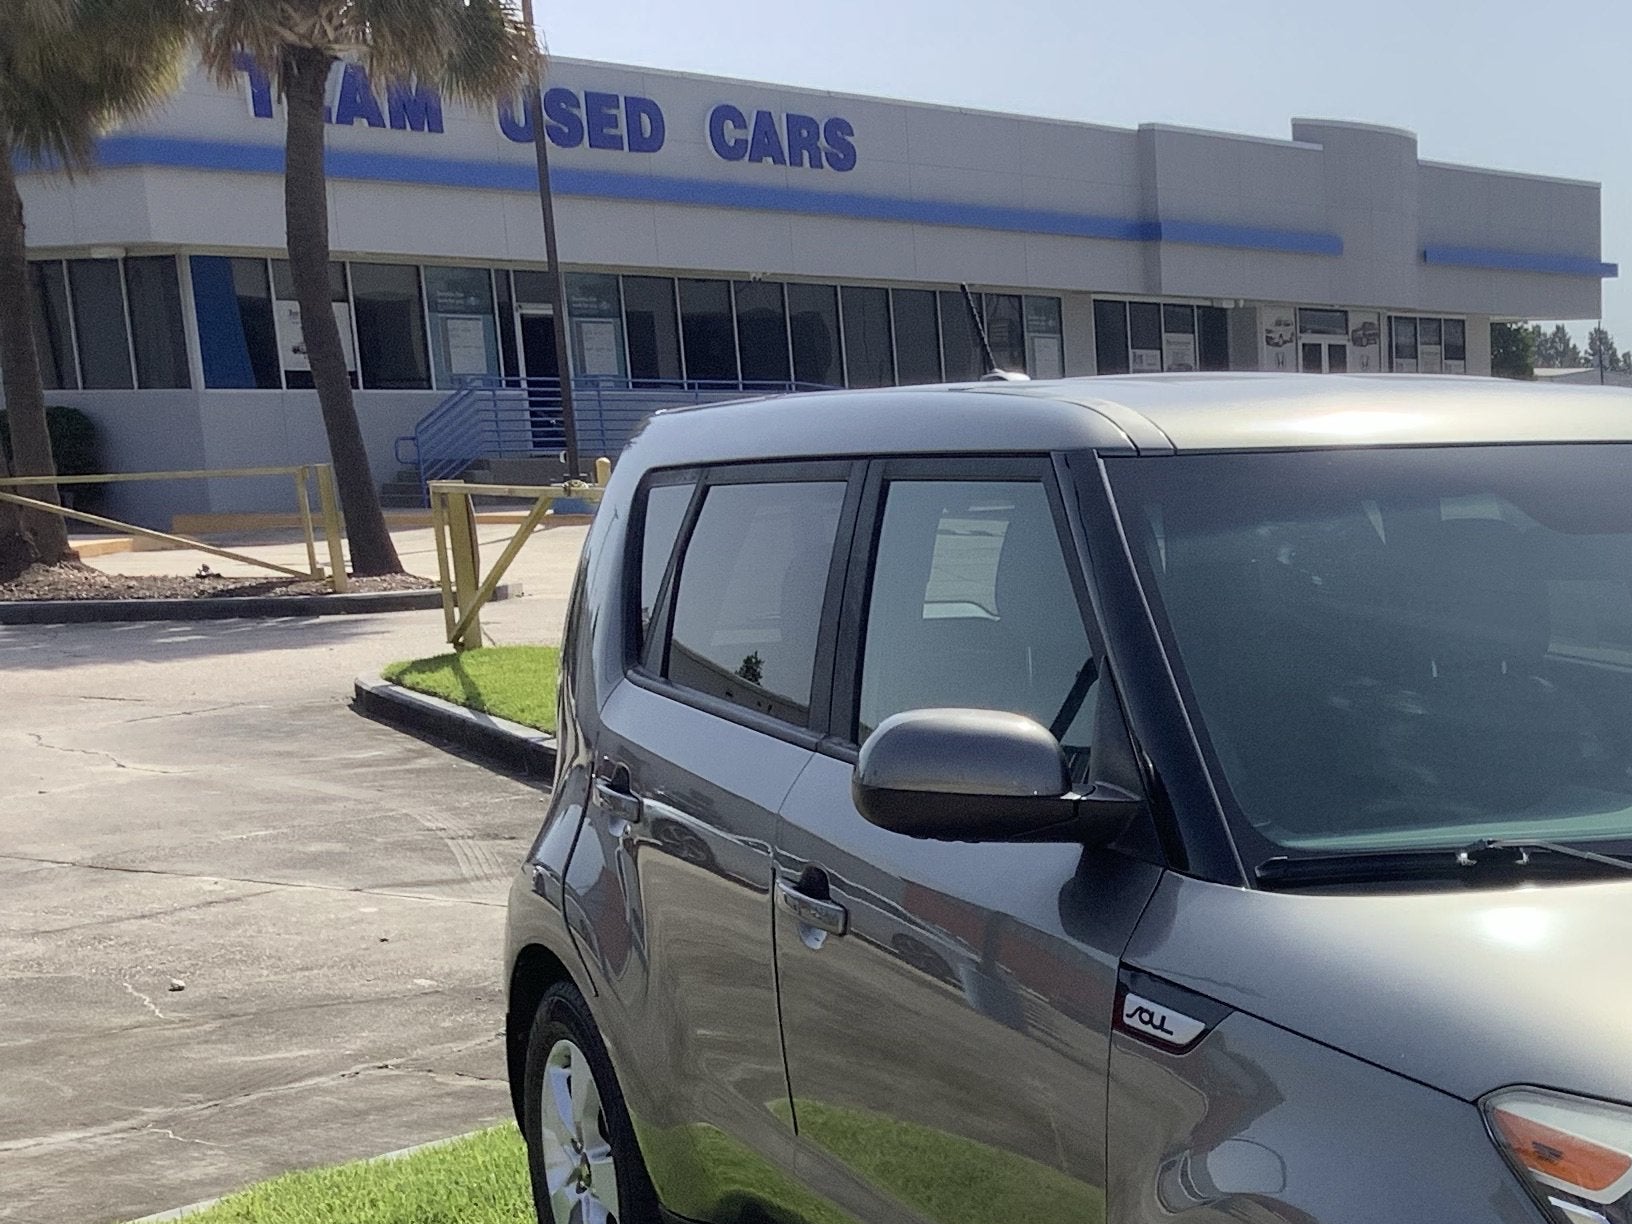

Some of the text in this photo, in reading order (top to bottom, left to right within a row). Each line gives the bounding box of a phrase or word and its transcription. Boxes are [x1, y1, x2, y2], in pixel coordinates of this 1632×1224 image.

[232, 53, 857, 172] TAM USED CARS
